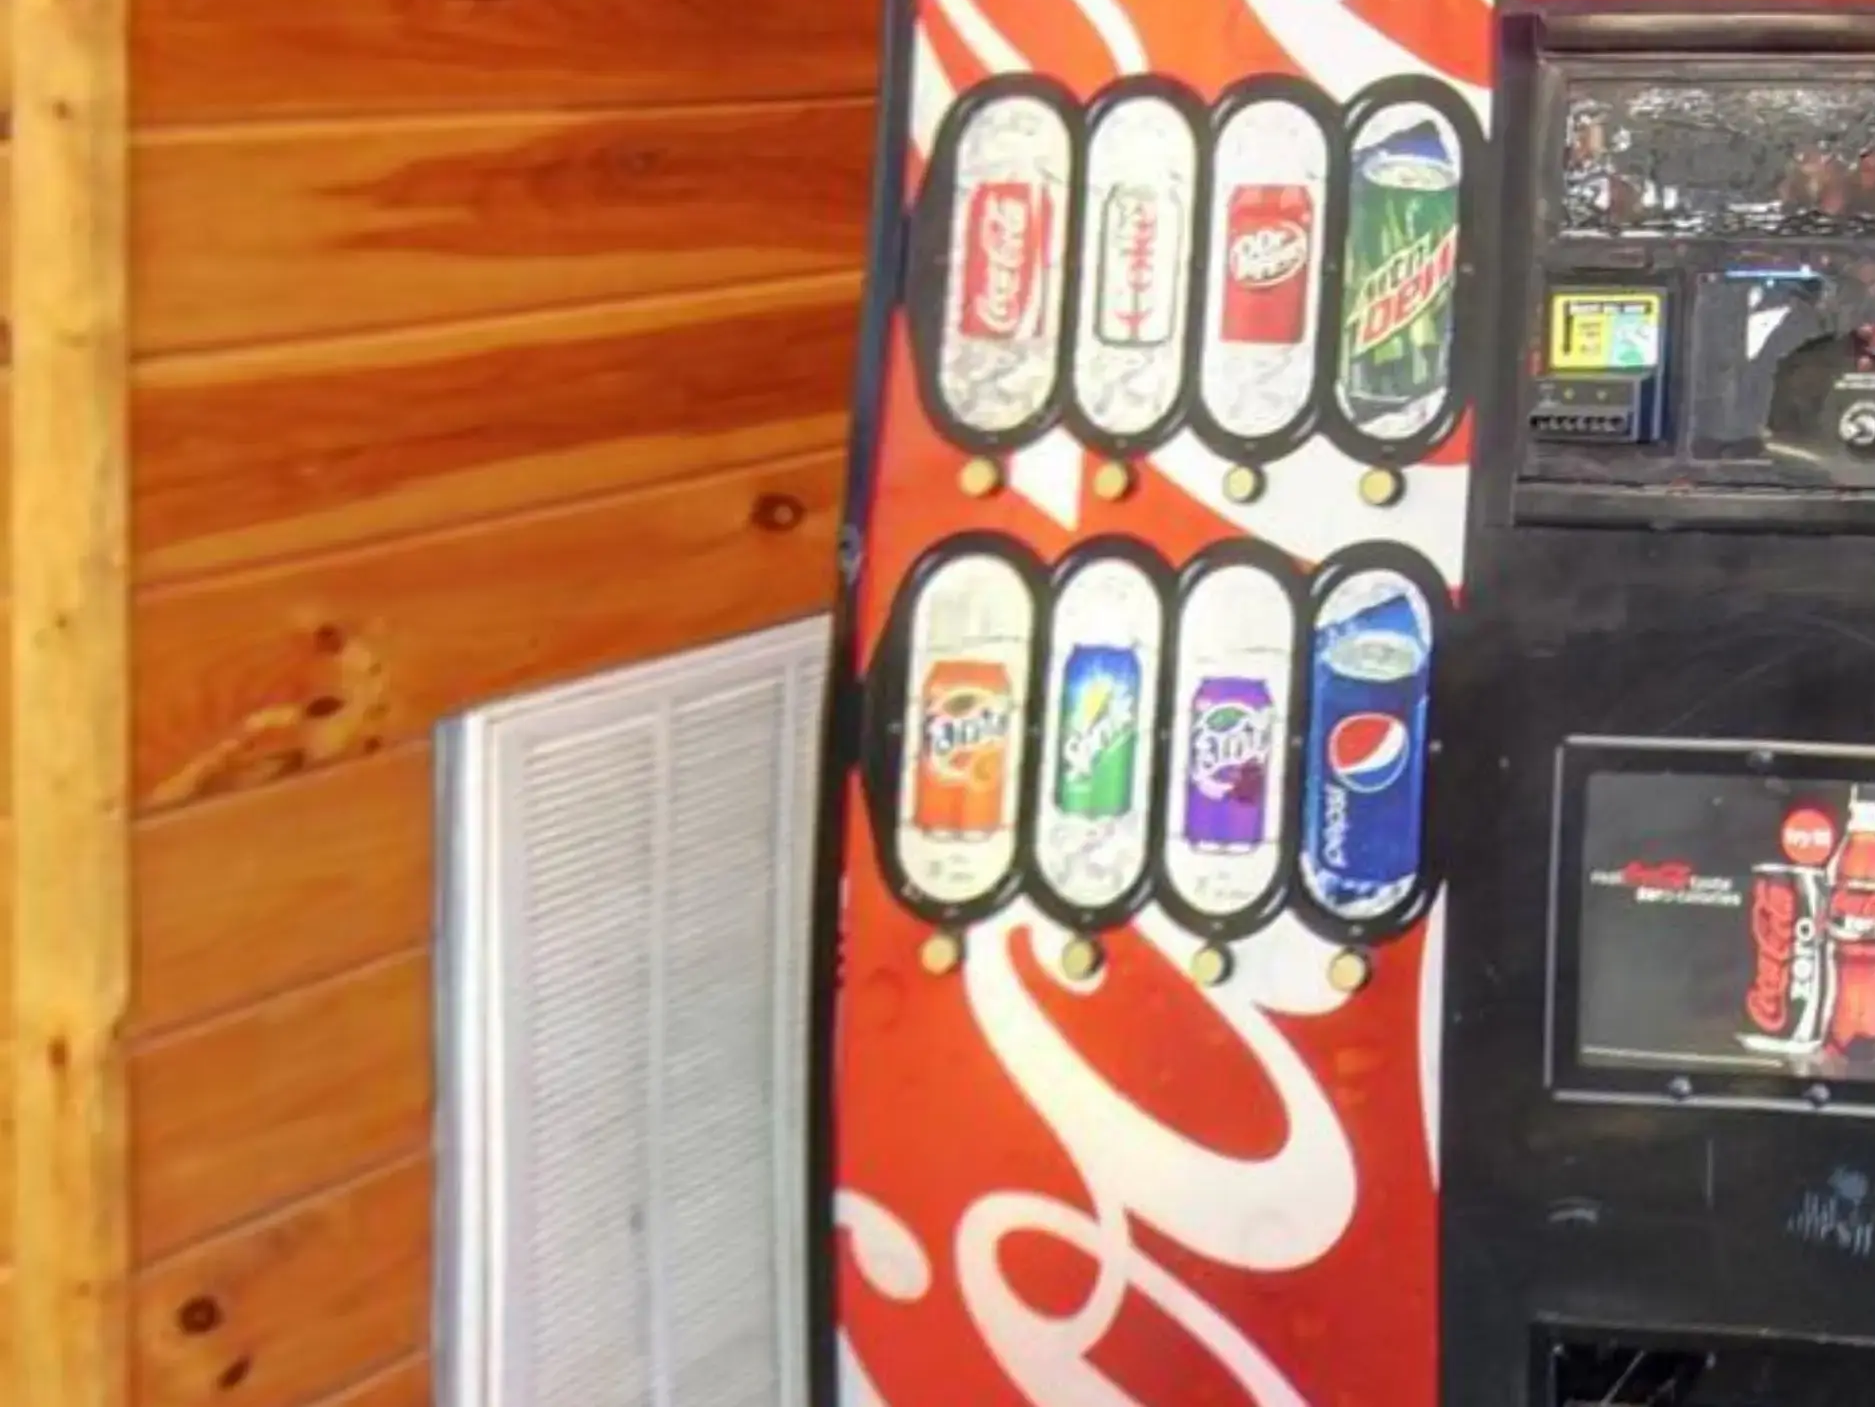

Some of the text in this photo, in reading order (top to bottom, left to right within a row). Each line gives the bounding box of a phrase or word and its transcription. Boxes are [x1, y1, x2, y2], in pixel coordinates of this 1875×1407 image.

[1322, 785, 1350, 868] pepsi
[1747, 874, 1797, 1032] Coca-Cola
[1790, 916, 1817, 1000] zero
